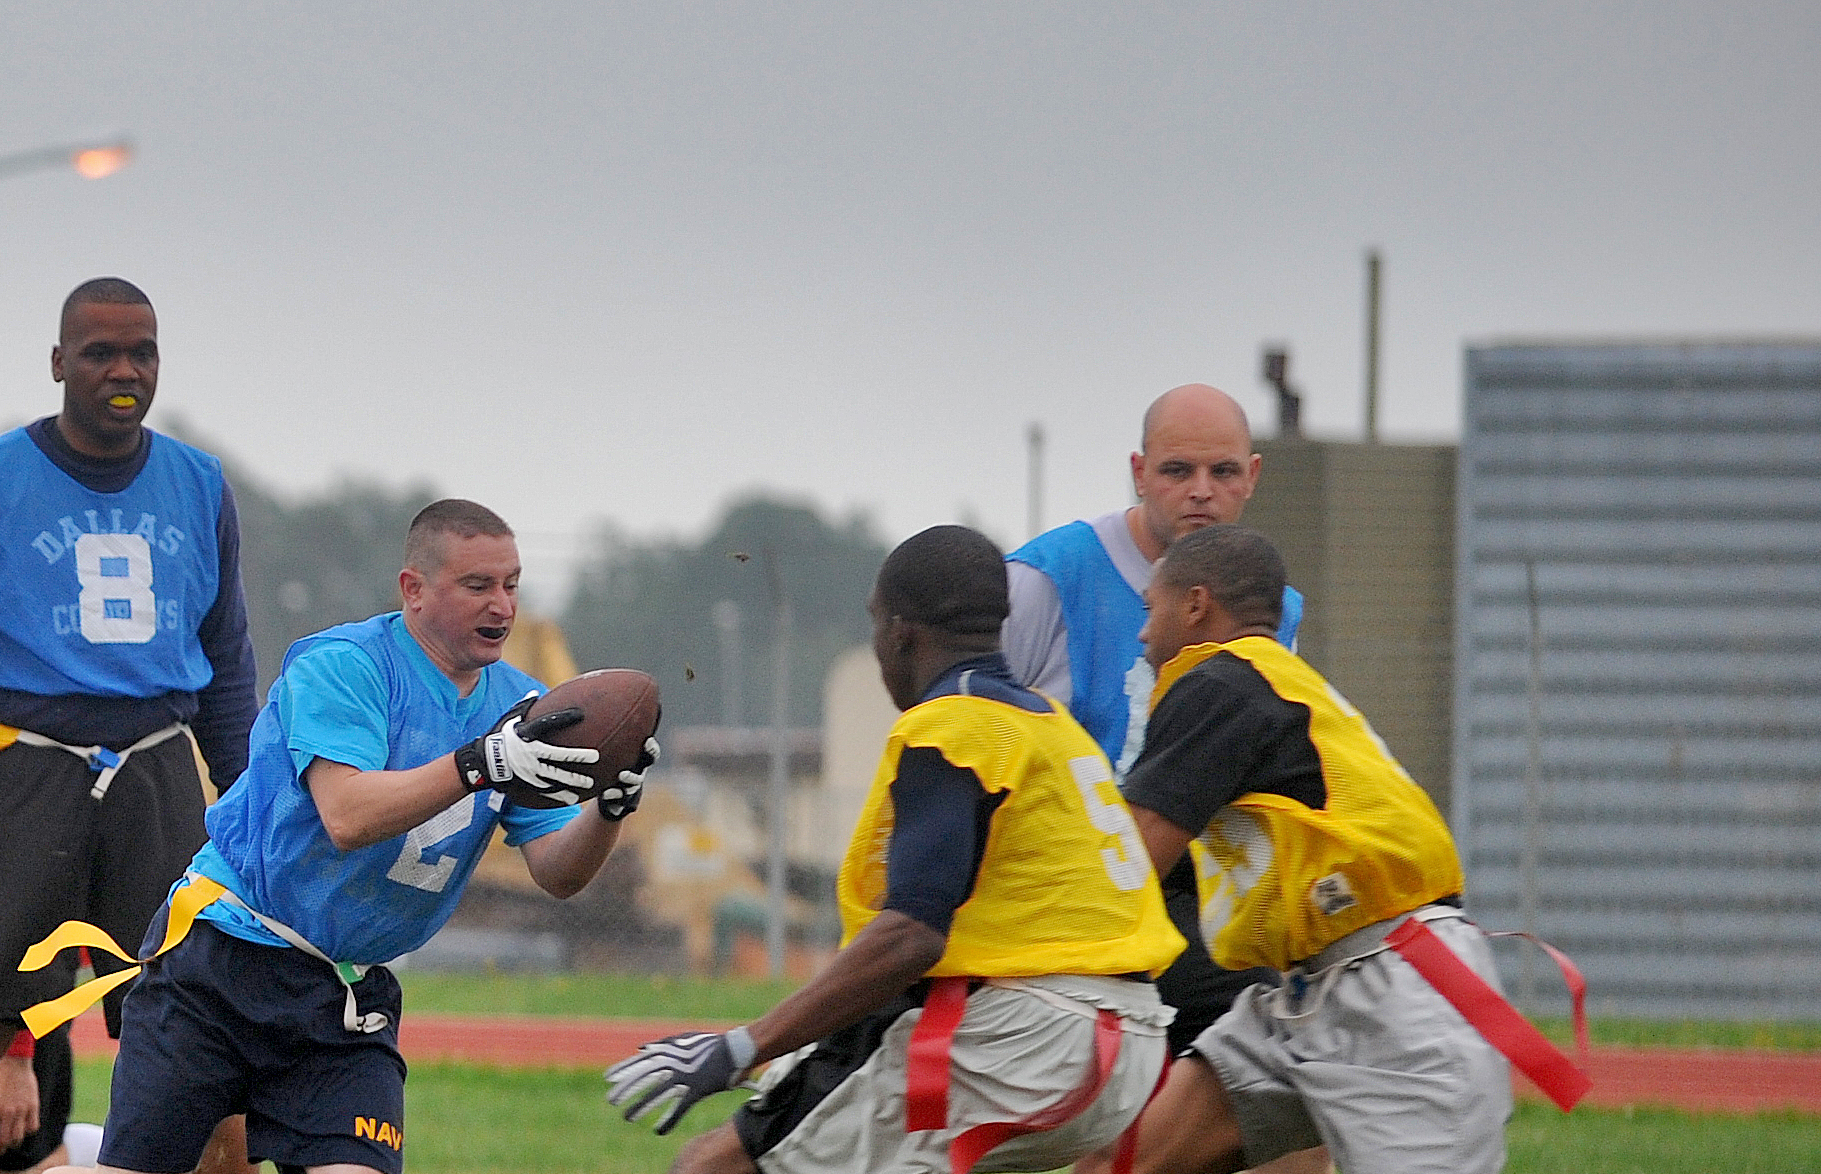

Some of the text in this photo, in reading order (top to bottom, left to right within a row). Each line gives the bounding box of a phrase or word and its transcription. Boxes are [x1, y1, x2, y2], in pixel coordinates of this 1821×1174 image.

[31, 508, 186, 565] DALLAS
[75, 533, 157, 643] 8
[1068, 755, 1151, 891] 5
